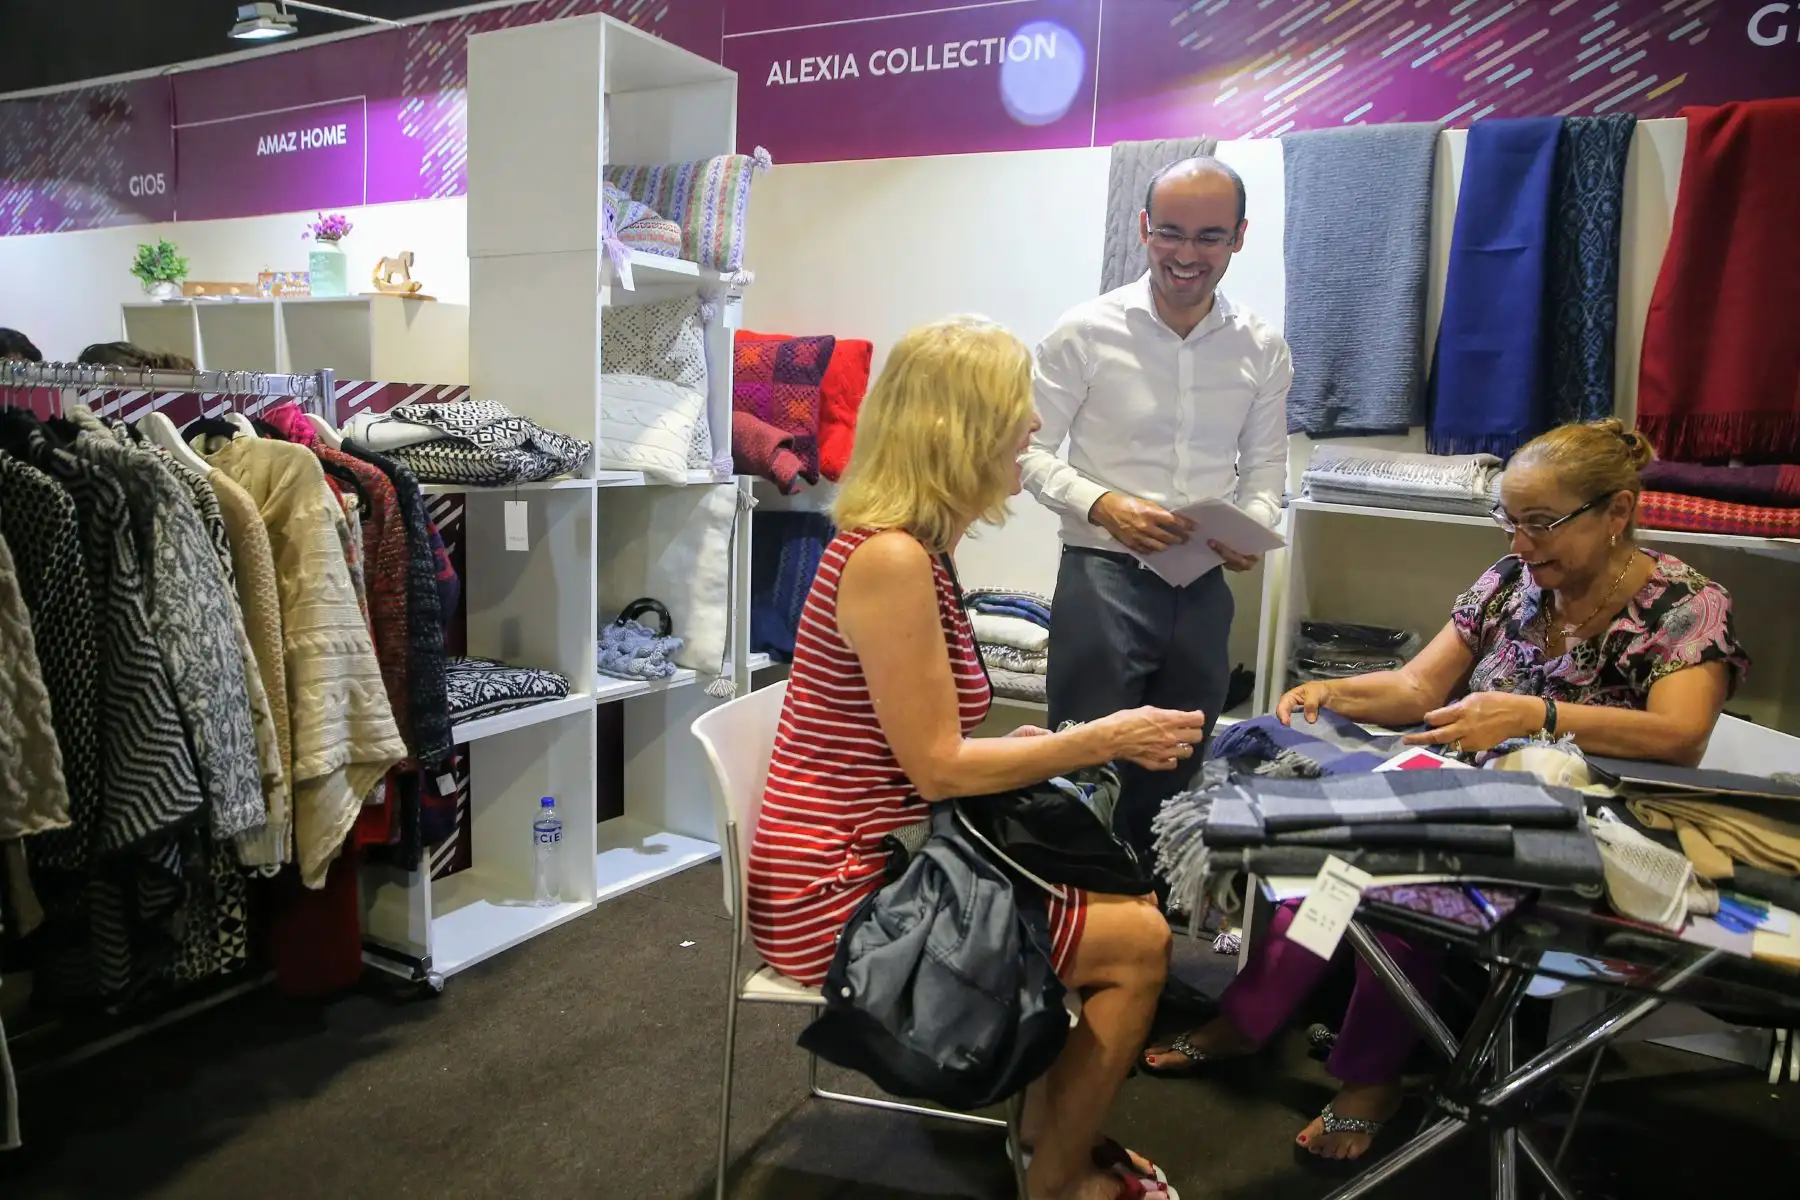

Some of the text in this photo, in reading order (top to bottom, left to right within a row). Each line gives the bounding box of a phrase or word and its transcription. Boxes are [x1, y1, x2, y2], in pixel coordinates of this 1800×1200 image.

[1747, 2, 1800, 46] G
[766, 31, 1057, 86] ALEXIA COLLECTION
[257, 124, 347, 156] AMAZ HOME
